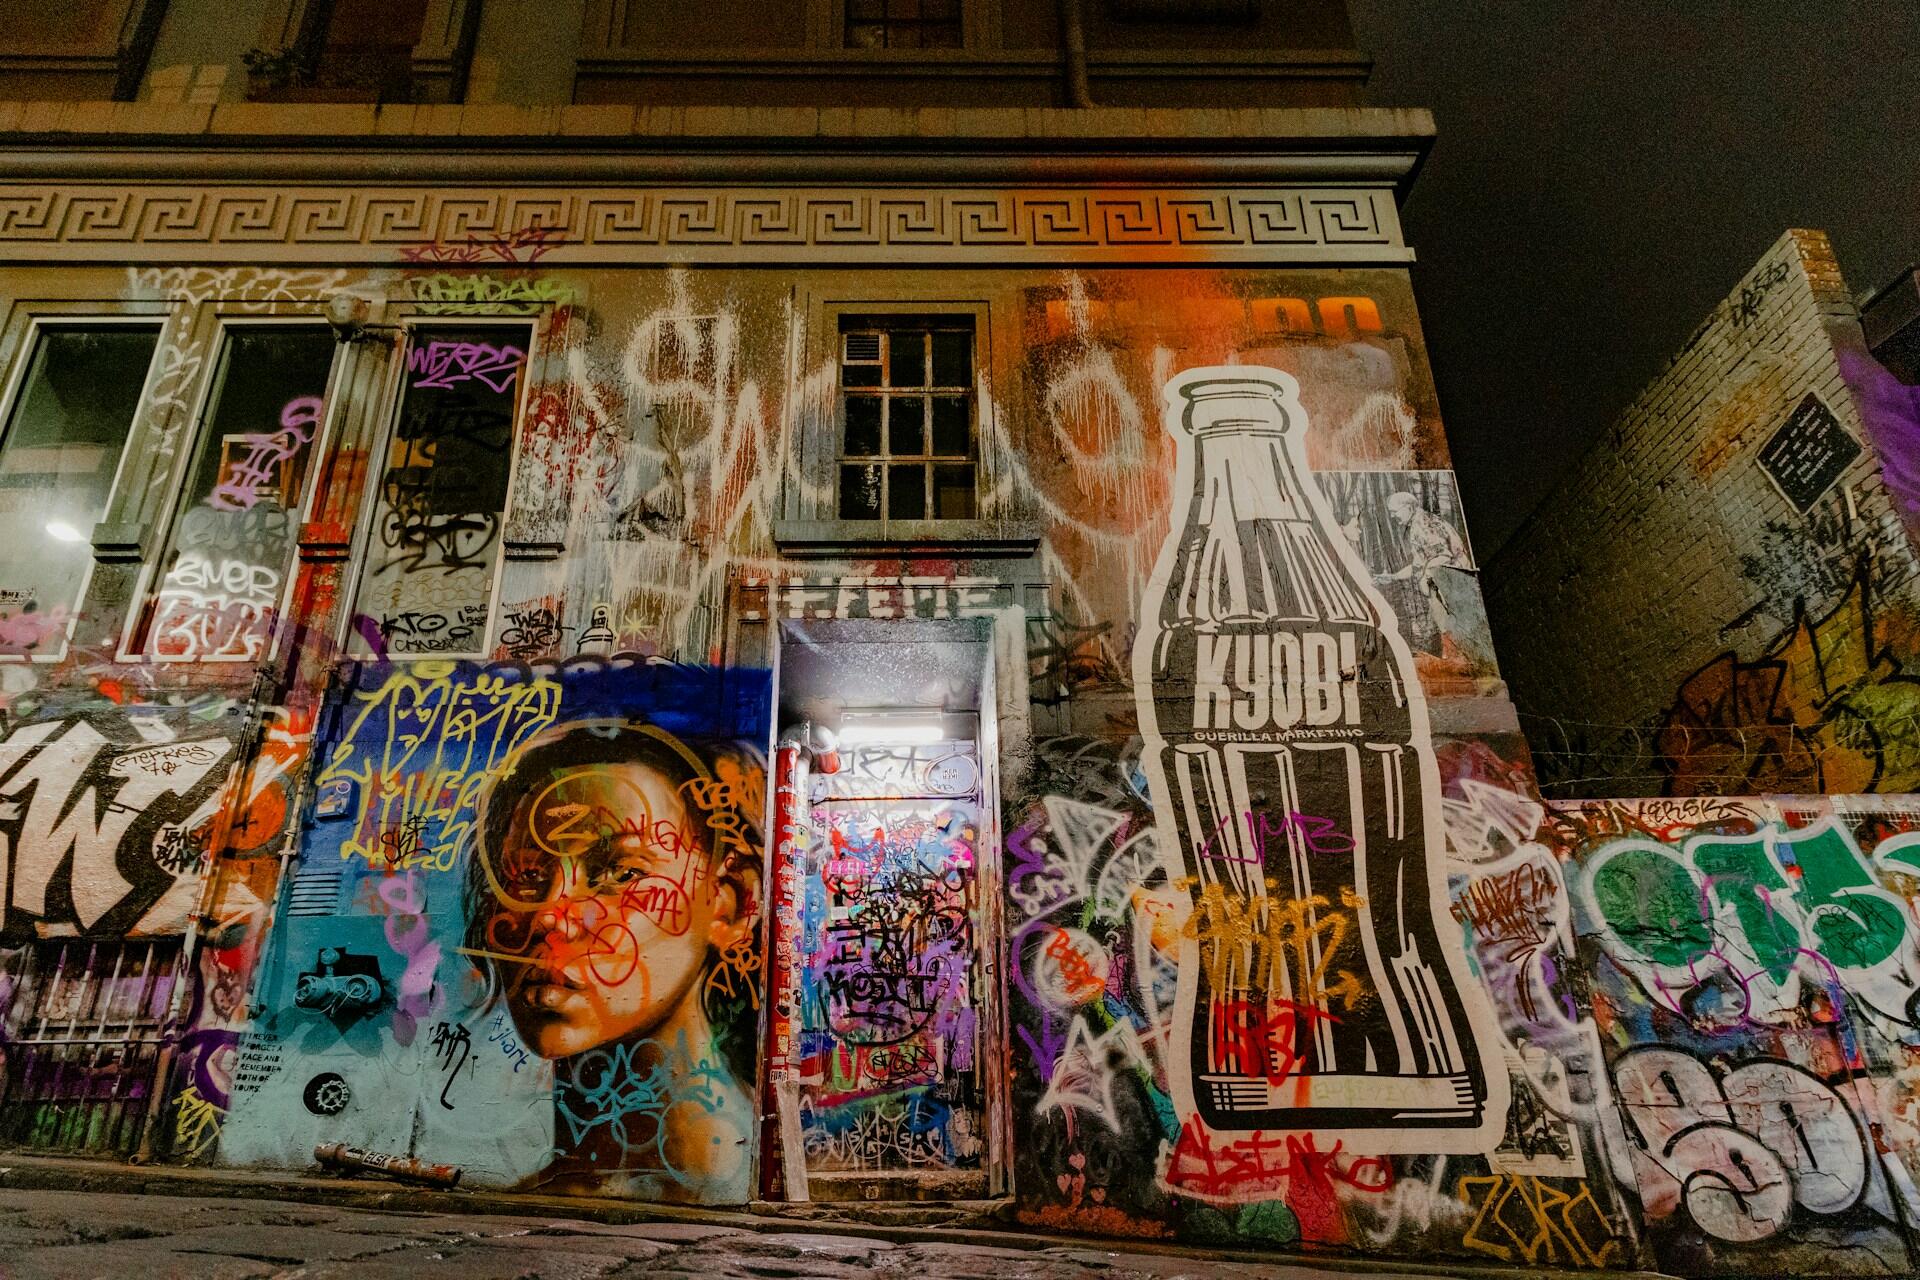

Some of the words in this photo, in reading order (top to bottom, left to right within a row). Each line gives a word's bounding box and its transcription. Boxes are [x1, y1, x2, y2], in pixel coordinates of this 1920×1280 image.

[1193, 631, 1361, 730] KYOBI
[1194, 731, 1272, 742] GUERILLA
[1275, 728, 1365, 742] MARKETING
[241, 1052, 262, 1061] FACE
[236, 1073, 257, 1081] BOTH
